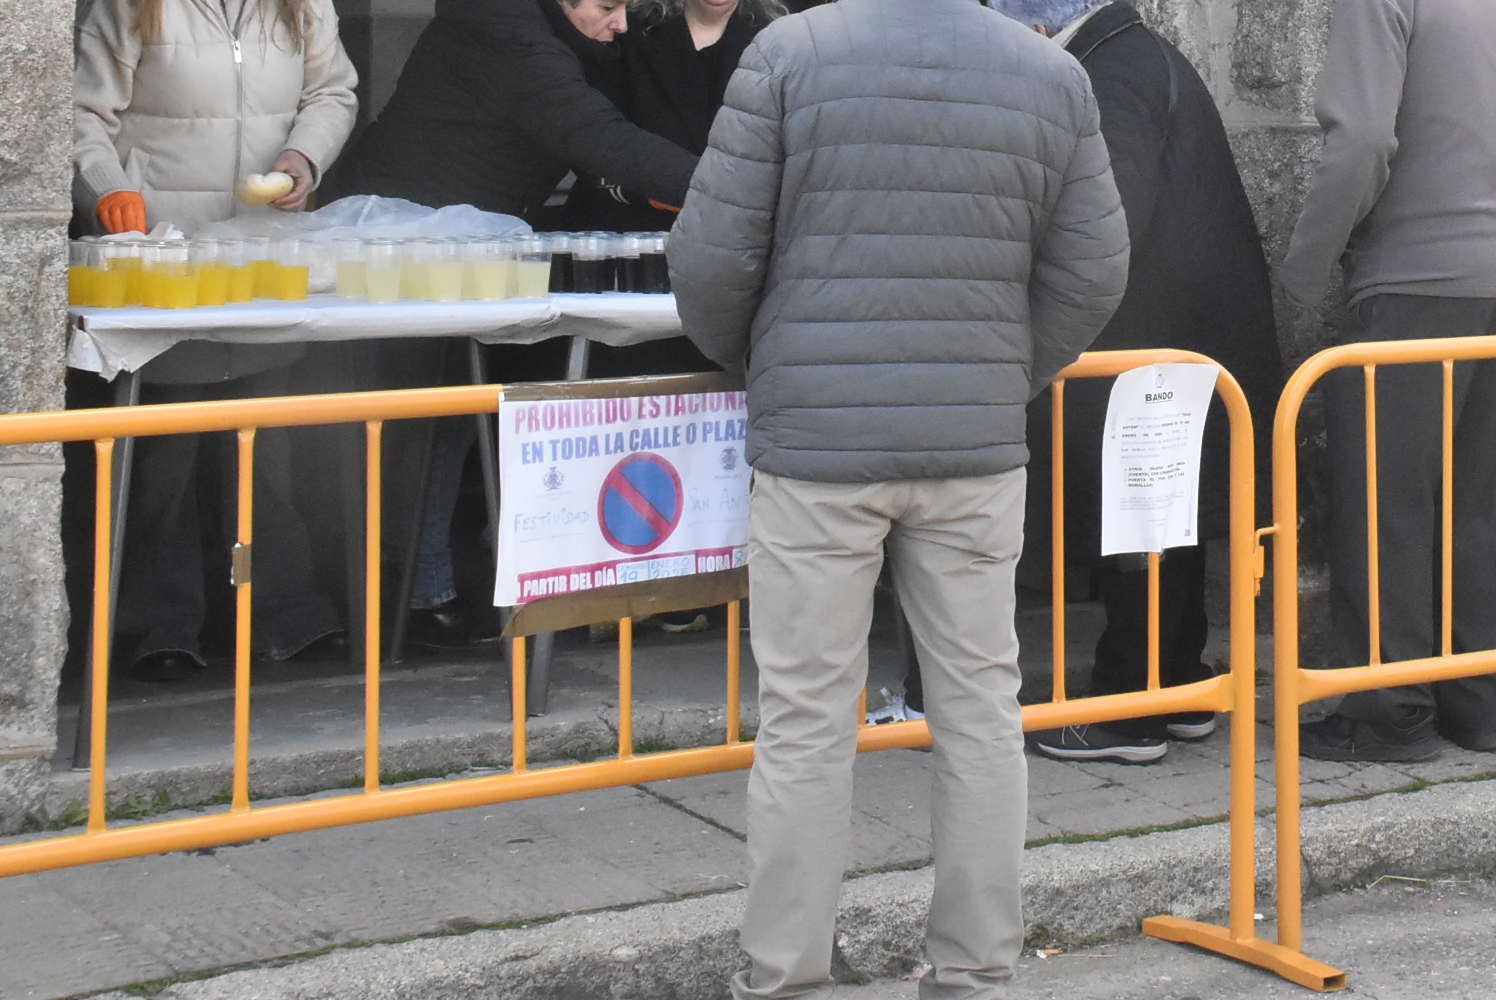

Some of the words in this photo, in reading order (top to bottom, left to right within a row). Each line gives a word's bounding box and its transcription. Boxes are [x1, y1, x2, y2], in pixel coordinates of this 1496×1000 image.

[515, 399, 632, 435] PROHIBIDO
[637, 392, 747, 420] ESTACIONA
[1145, 391, 1173, 402] BANDO
[521, 441, 544, 465] EN
[549, 435, 600, 461] TODA
[604, 432, 625, 455] LA
[629, 426, 681, 451] CALLE
[686, 422, 697, 445] O
[702, 419, 747, 442] PLAZ
[523, 574, 567, 598] PARTIR
[570, 571, 593, 593] DEL
[595, 566, 616, 588] DÍA
